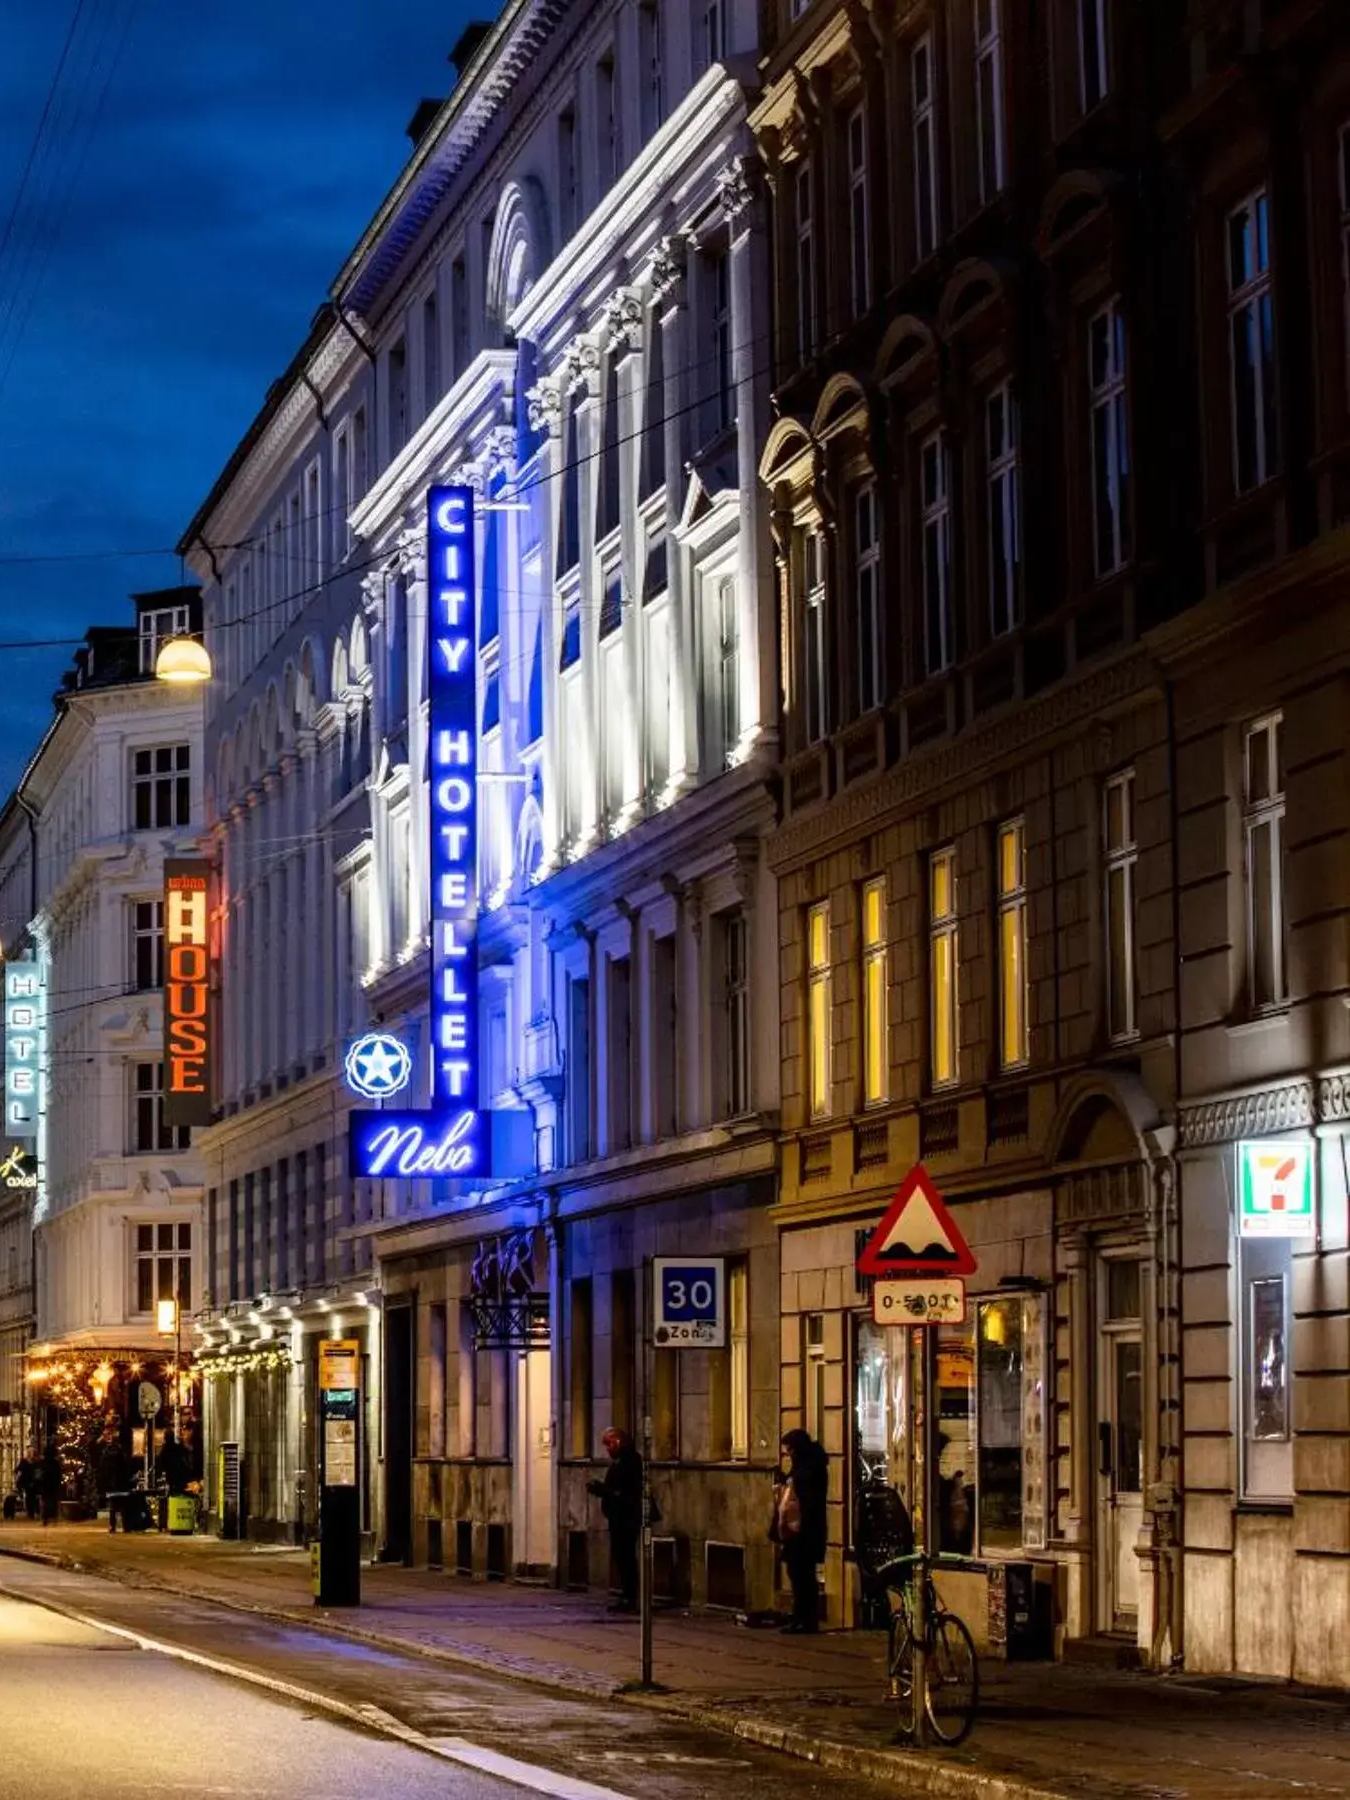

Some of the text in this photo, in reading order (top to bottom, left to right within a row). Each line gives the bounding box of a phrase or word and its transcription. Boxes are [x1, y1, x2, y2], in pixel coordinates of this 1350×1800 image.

[437, 499, 471, 1096] CITY HOTELLET
[167, 891, 208, 1093] HOUSE
[10, 976, 34, 1122] HOTEL
[368, 1110, 474, 1175] Nebo
[6, 1173, 37, 1188] axel
[666, 1281, 712, 1310] 30
[670, 1326, 712, 1340] Zon
